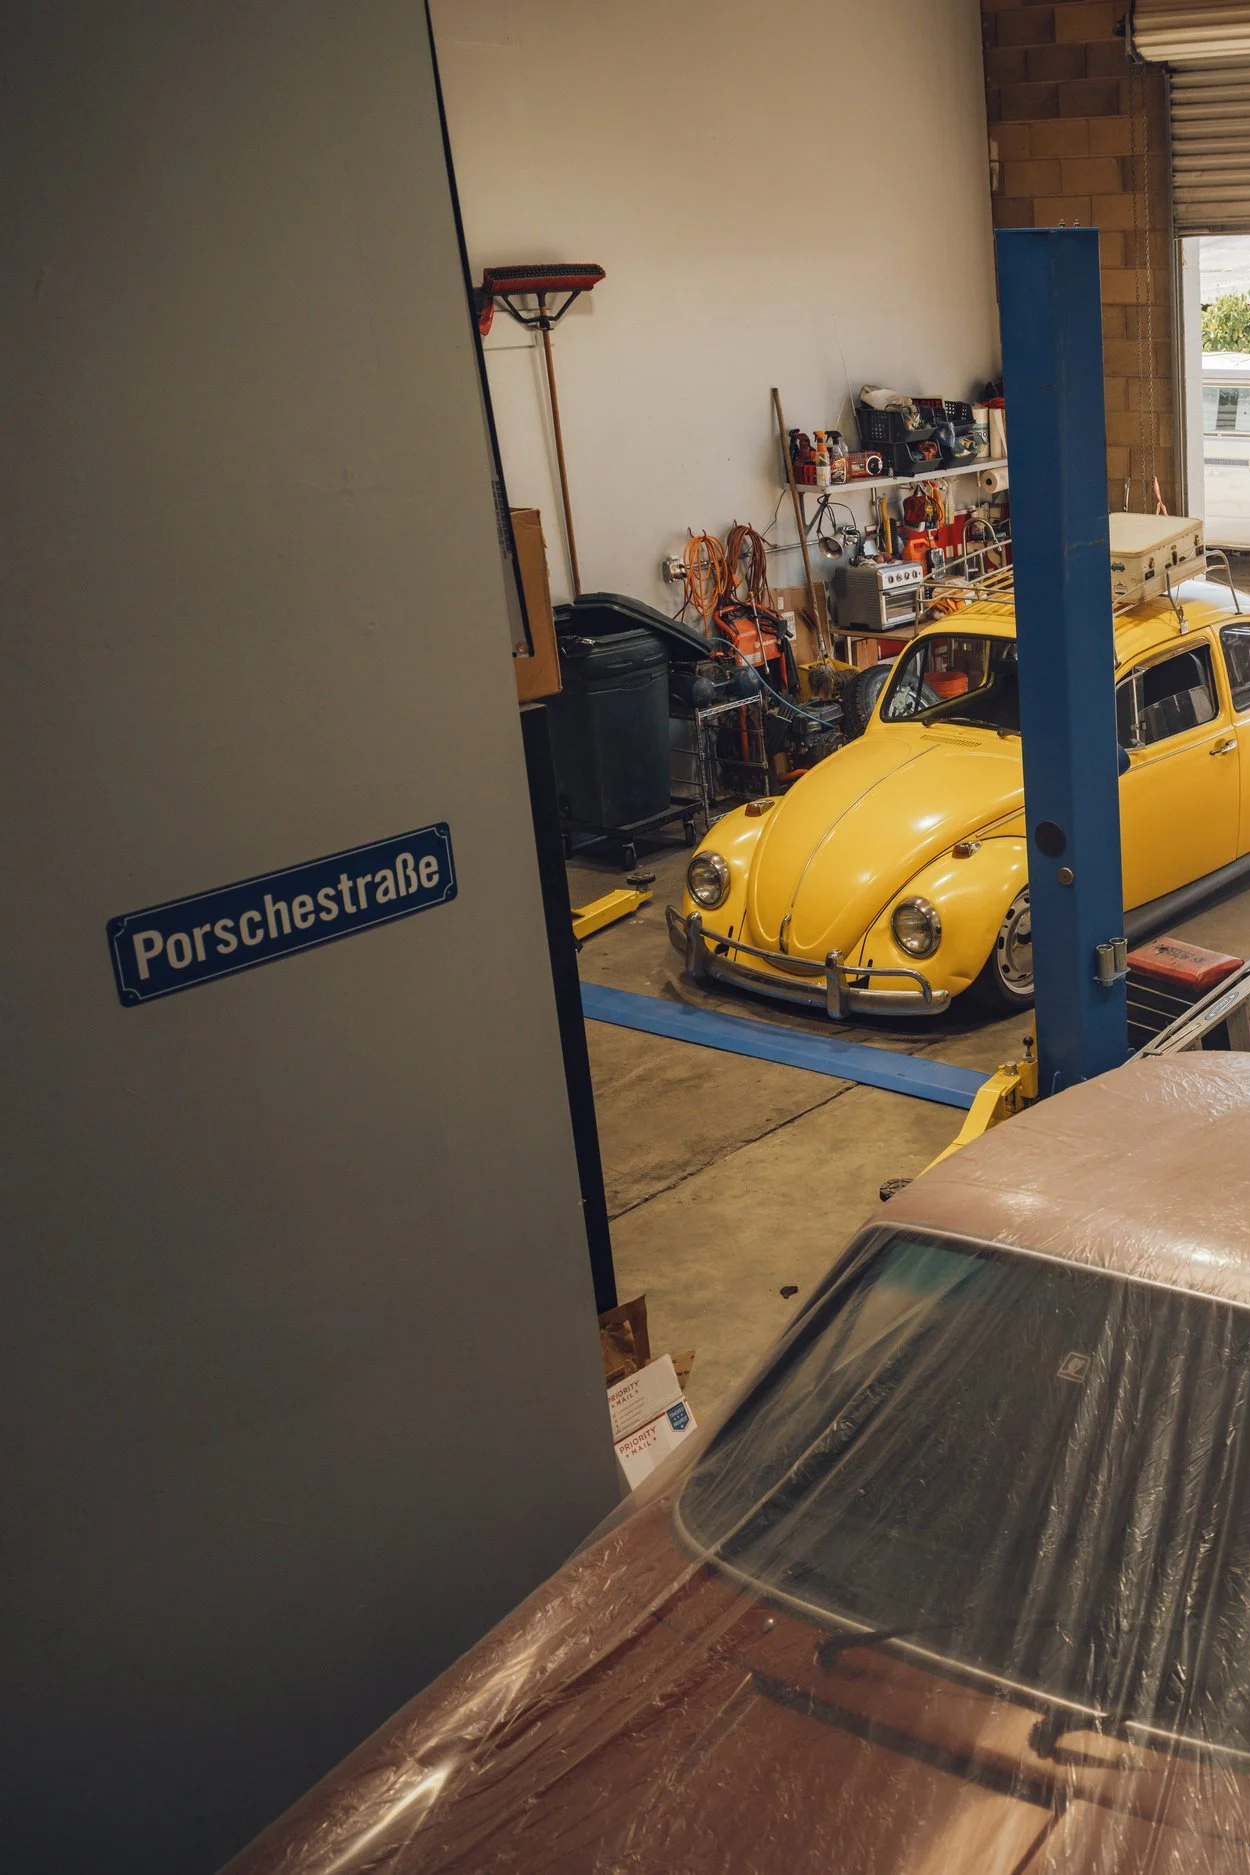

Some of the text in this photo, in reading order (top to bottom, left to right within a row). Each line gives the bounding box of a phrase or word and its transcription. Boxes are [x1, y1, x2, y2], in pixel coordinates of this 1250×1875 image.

[131, 851, 440, 981] Porschestraße
[608, 1380, 639, 1402] PRIORITY
[615, 1393, 634, 1407] MAIL
[619, 1426, 656, 1454] PRIORITY
[631, 1442, 651, 1456] MAIL
